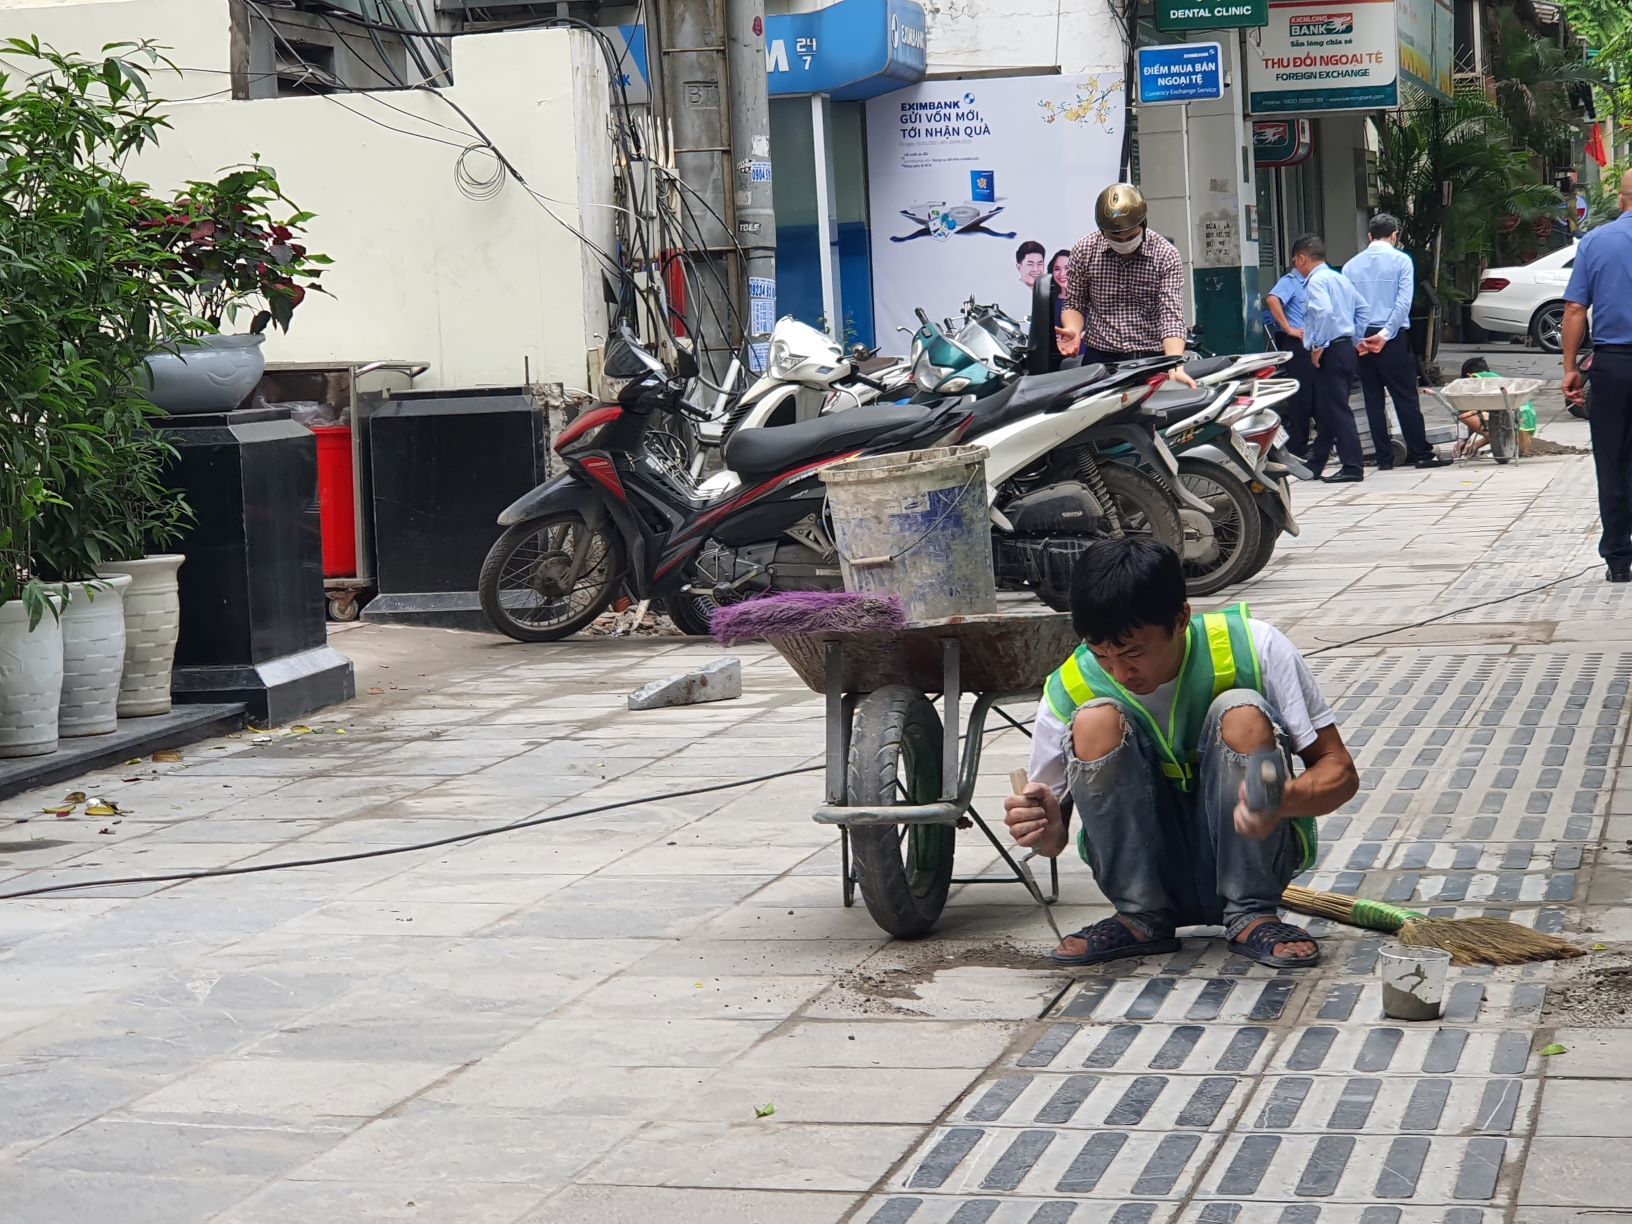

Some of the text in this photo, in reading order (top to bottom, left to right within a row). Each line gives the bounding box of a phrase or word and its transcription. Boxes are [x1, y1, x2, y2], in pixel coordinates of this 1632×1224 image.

[1170, 5, 1252, 19] DENTAL CLINIC
[1291, 24, 1327, 36] BANK
[796, 38, 816, 52] 24
[802, 56, 811, 71] 7
[1262, 51, 1383, 69] THU ĐỔI NGOẠI TỆ
[1143, 61, 1216, 76] ĐIỂM MUA BÁN
[1275, 68, 1370, 81] FOREIGN EXCHANGE
[1157, 73, 1204, 87] NGOẠI TỆ
[900, 101, 960, 111] EXIMBANK
[900, 108, 984, 124] GỬI VỐN MỚI,
[900, 123, 991, 140] TỚI NHẬN QUÀ
